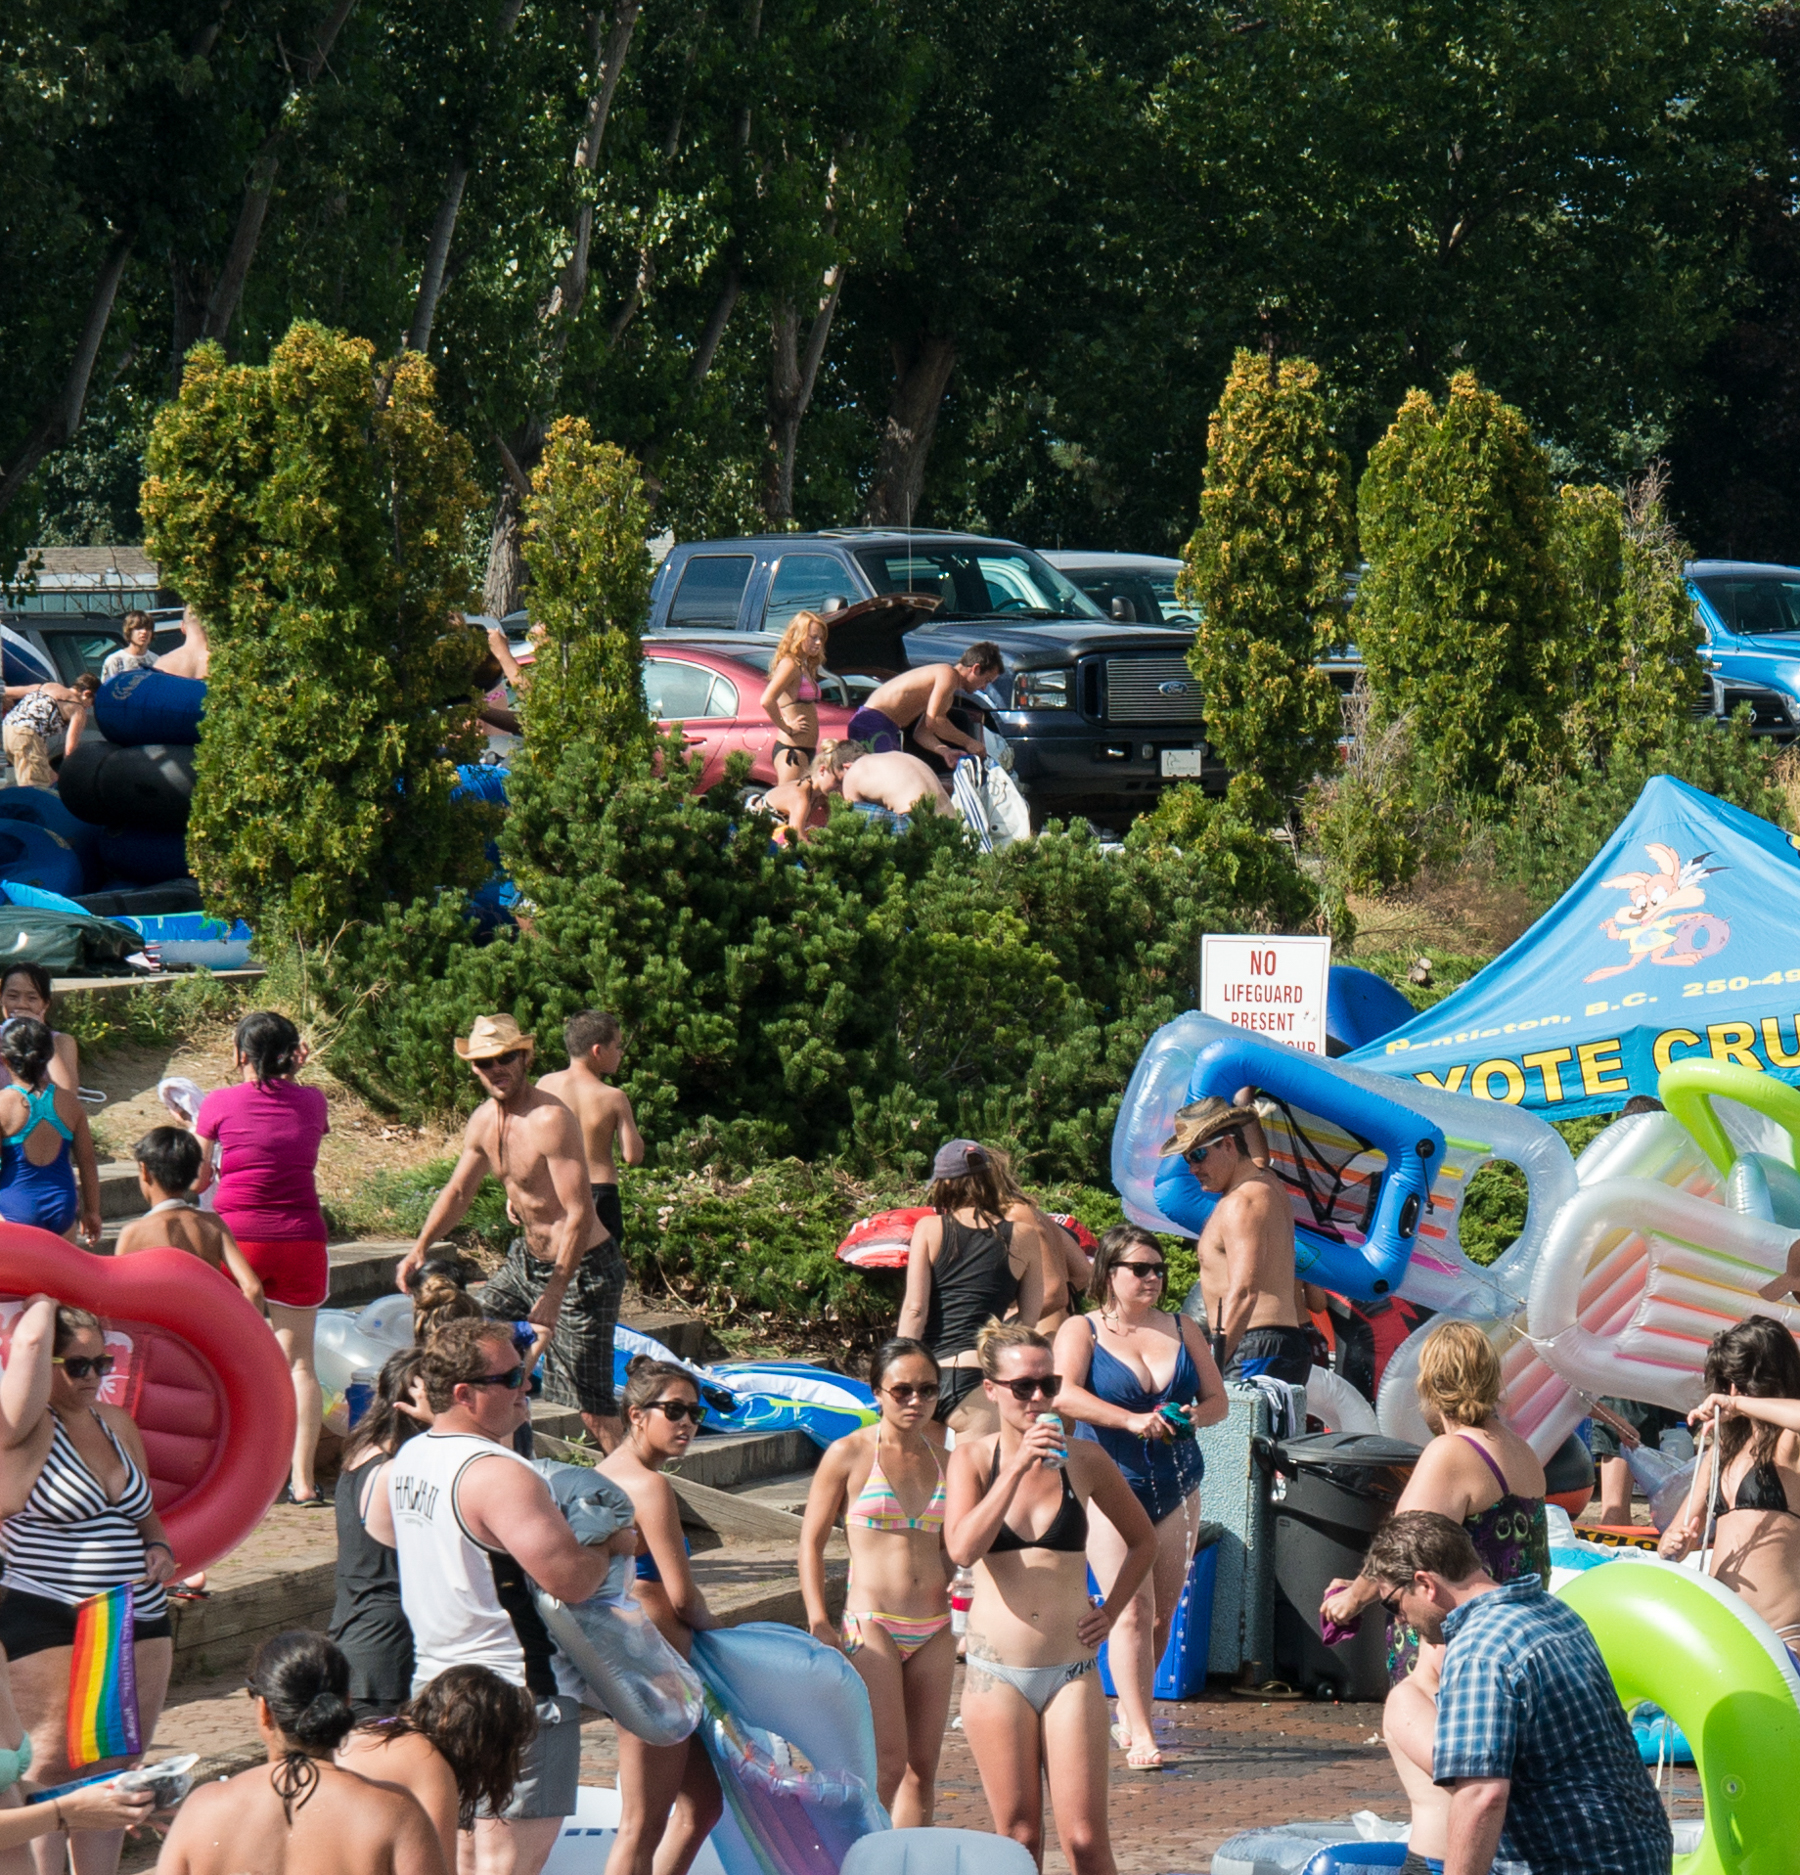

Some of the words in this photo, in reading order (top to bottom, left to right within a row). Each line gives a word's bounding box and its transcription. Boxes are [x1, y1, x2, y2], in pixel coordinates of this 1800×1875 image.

[1250, 950, 1277, 976] NO
[1224, 984, 1303, 1003] LIFEGUARD
[1231, 1012, 1295, 1031] PRESENT
[1573, 1527, 1660, 1551] XPLO
